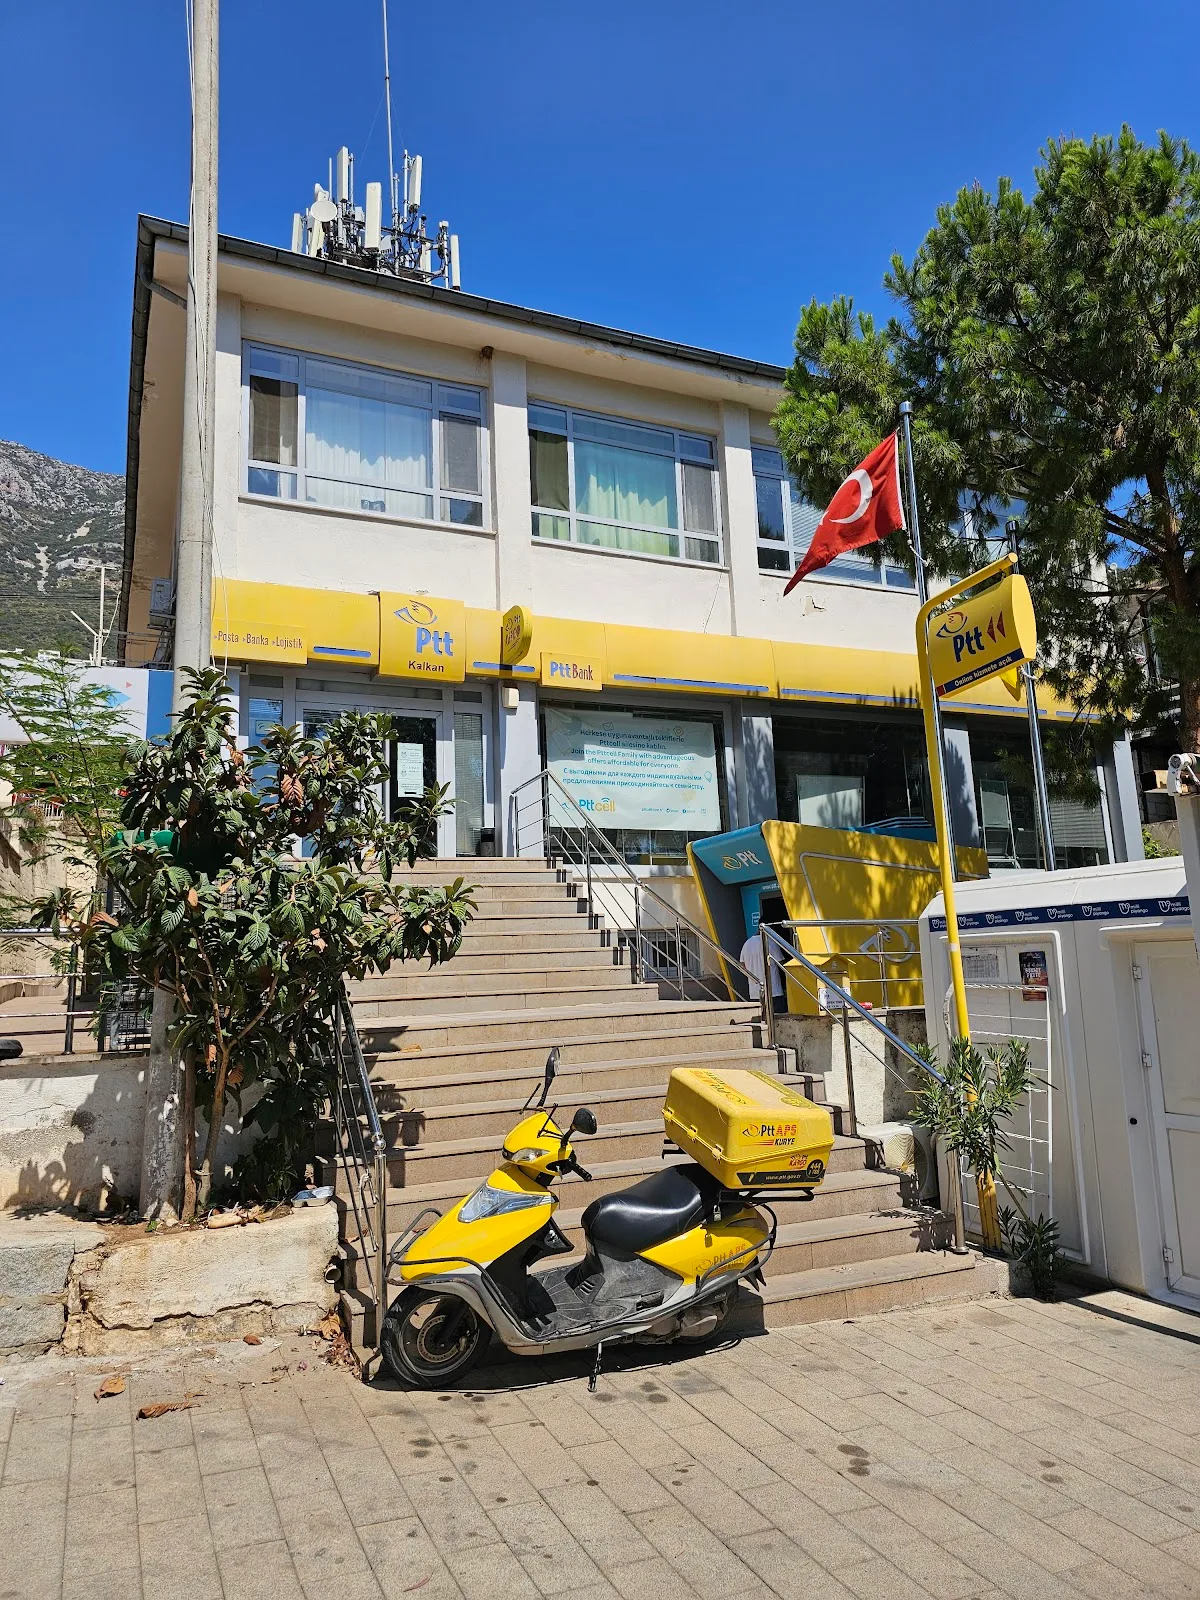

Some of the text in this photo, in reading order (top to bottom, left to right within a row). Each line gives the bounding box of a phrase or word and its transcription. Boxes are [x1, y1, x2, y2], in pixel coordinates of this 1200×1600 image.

[218, 631, 302, 649] Posta Banka Lojistik
[416, 627, 453, 656] Ptt
[953, 626, 985, 662] Ptt
[408, 660, 444, 672] Kalkan
[954, 675, 973, 686] Online
[998, 656, 1012, 668] açık
[579, 799, 615, 812] Pttcell
[736, 850, 763, 867] Ptt
[774, 1138, 795, 1146] KURYE
